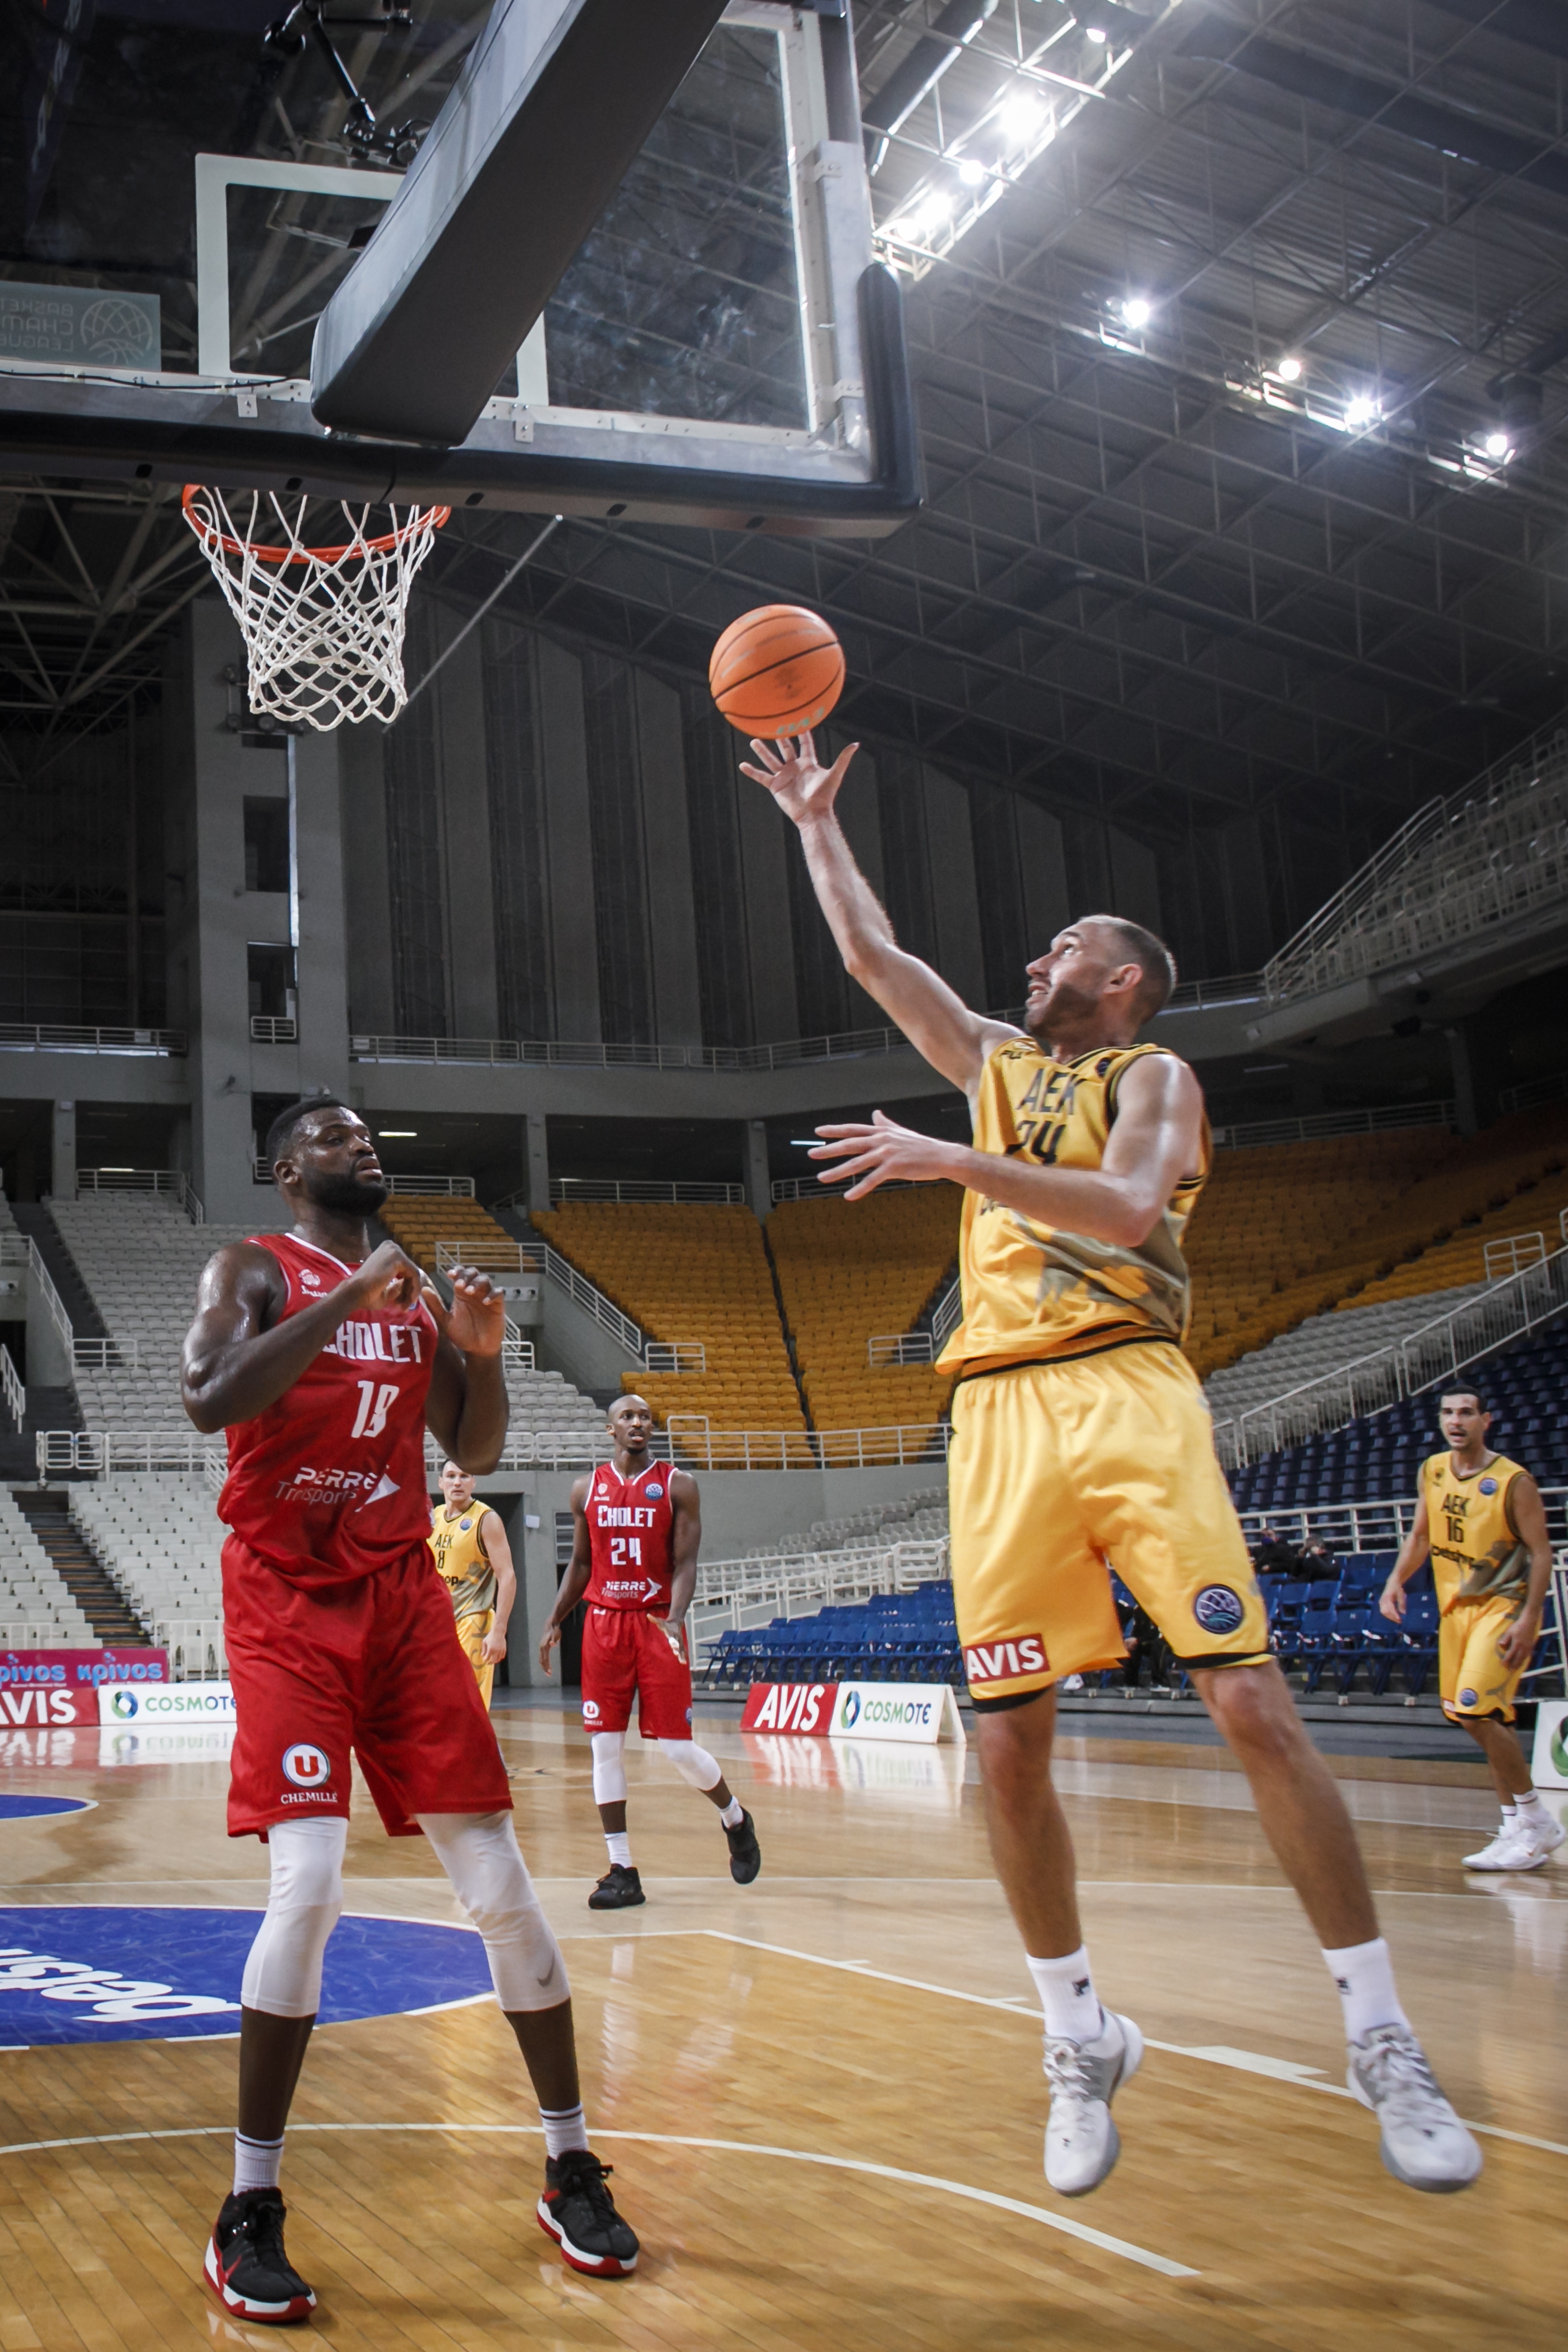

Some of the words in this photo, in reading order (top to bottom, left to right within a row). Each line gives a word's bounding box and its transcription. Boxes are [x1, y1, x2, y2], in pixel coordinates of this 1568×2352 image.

[1015, 1068, 1088, 1115] AEK
[597, 1505, 656, 1527] CHOLET
[1440, 1493, 1471, 1517] AEK
[435, 1534, 454, 1549] AEK
[1446, 1516, 1465, 1543] 16
[437, 1550, 445, 1569] 8
[611, 1537, 642, 1565] 24
[967, 1638, 1044, 1680] AVIS
[0, 1689, 76, 1725] VIS
[754, 1684, 825, 1732] AVIS
[864, 1700, 932, 1724] COSMOTE
